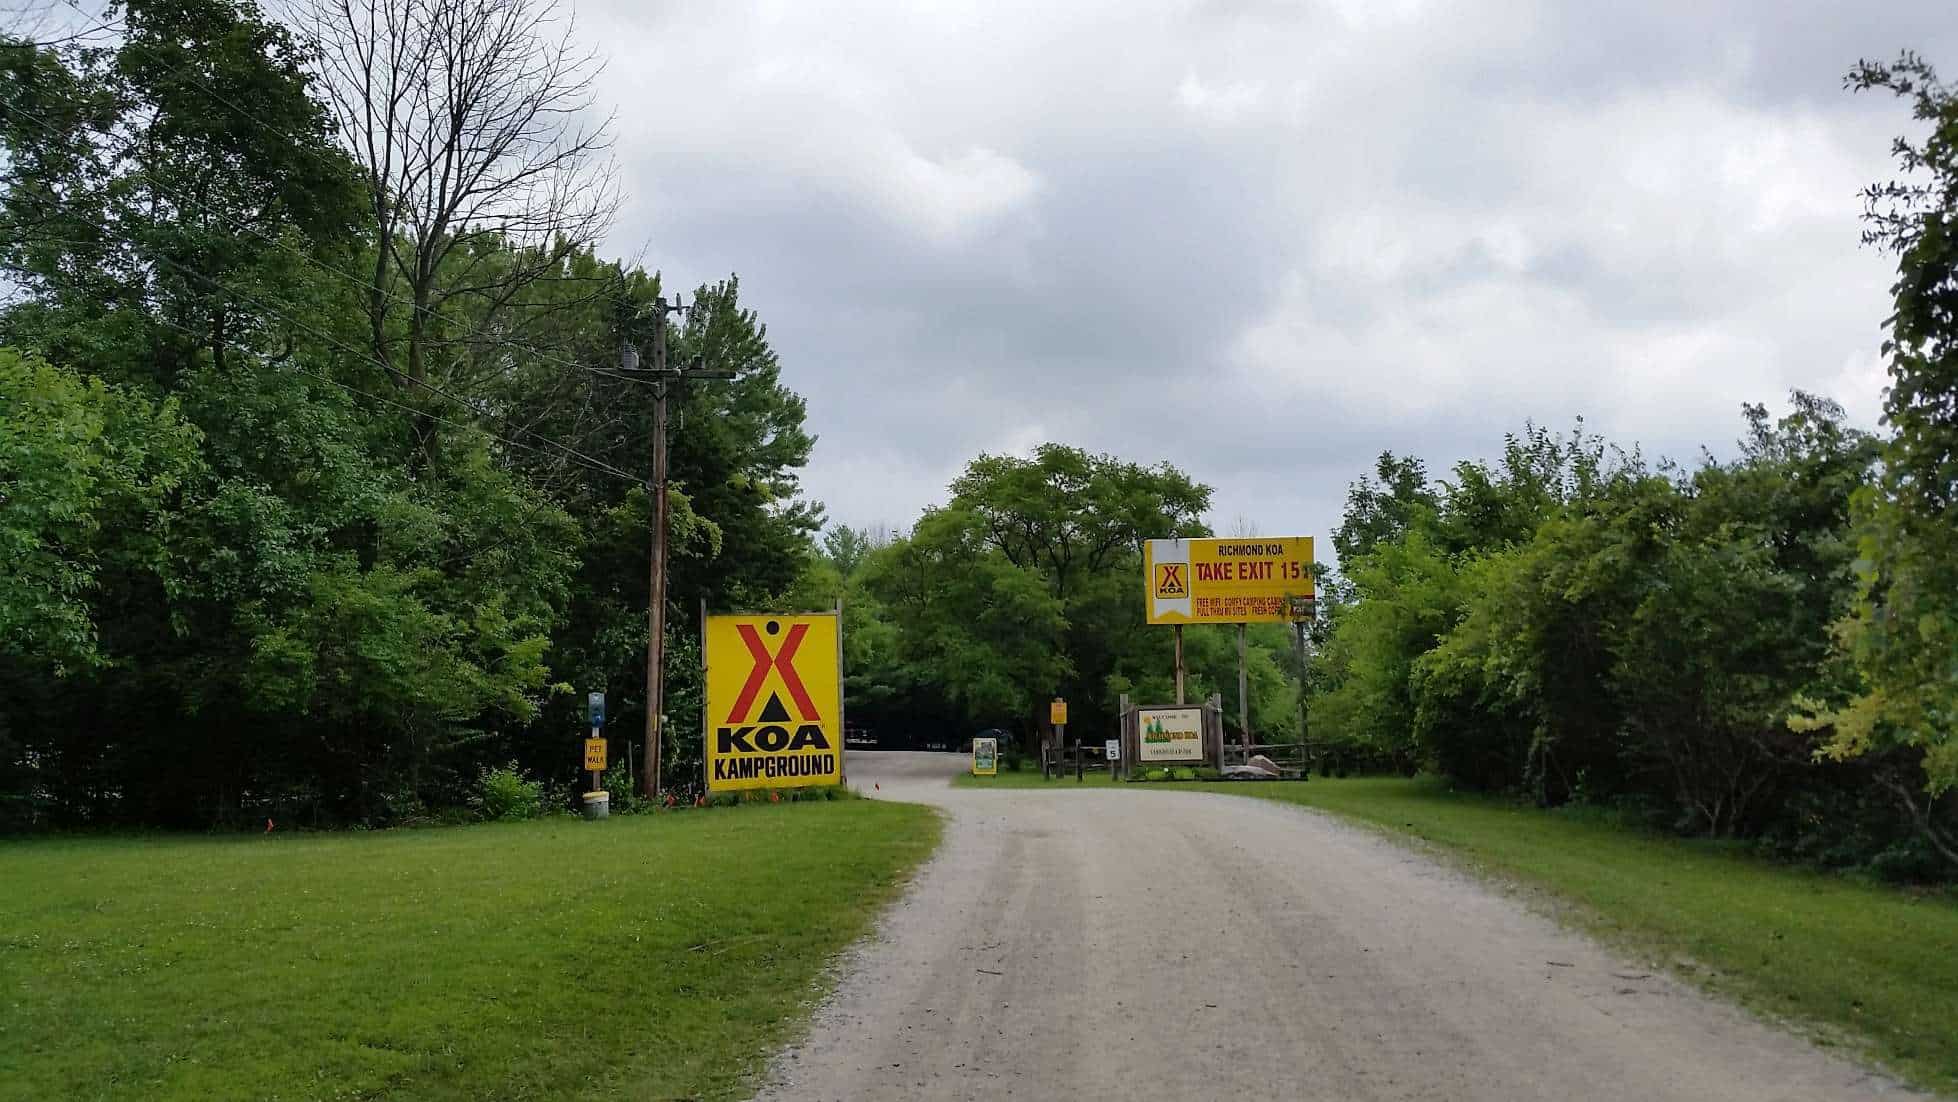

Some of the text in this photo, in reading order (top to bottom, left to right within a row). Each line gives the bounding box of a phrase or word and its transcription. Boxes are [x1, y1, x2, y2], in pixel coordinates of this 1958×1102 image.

[1218, 544, 1284, 556] RICHMOND KOA
[1196, 561, 1312, 581] TAKE EXIT 15
[717, 725, 830, 753] KOA
[587, 756, 604, 764] WALK
[1110, 750, 1117, 758] 5
[714, 754, 835, 780] KAMPGROUND
